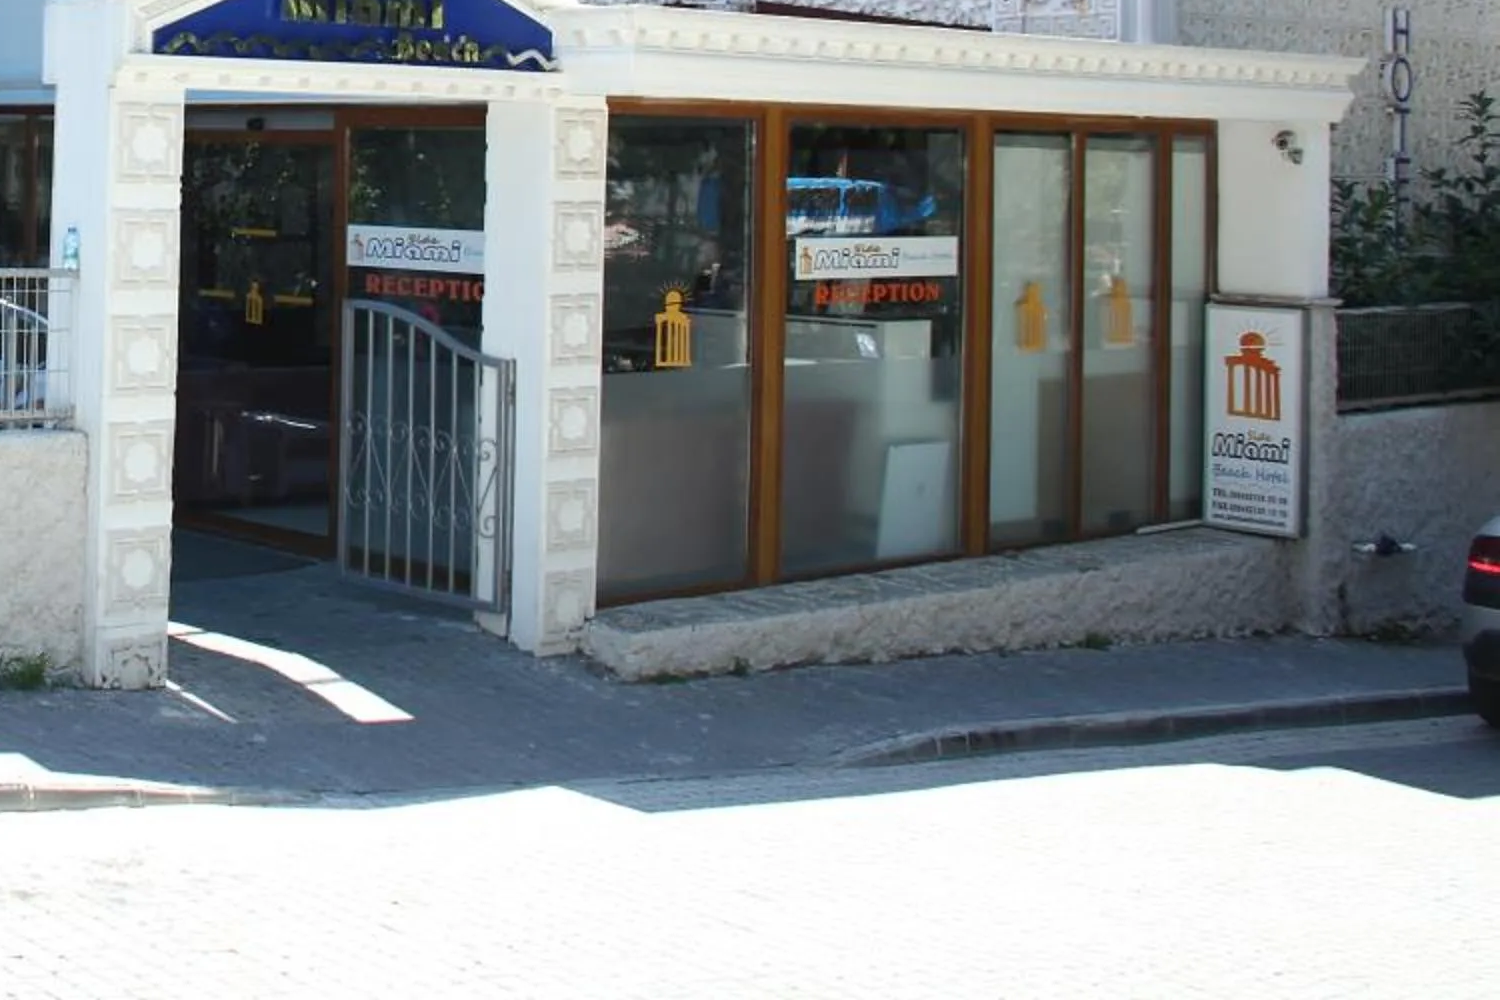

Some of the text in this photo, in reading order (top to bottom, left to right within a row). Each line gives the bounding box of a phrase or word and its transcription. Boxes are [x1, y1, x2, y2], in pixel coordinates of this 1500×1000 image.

[365, 237, 462, 263] Miami
[813, 248, 900, 271] Miami
[365, 273, 484, 300] RECEPTIO
[814, 281, 942, 306] RECEPTION
[1211, 432, 1291, 465] Miami
